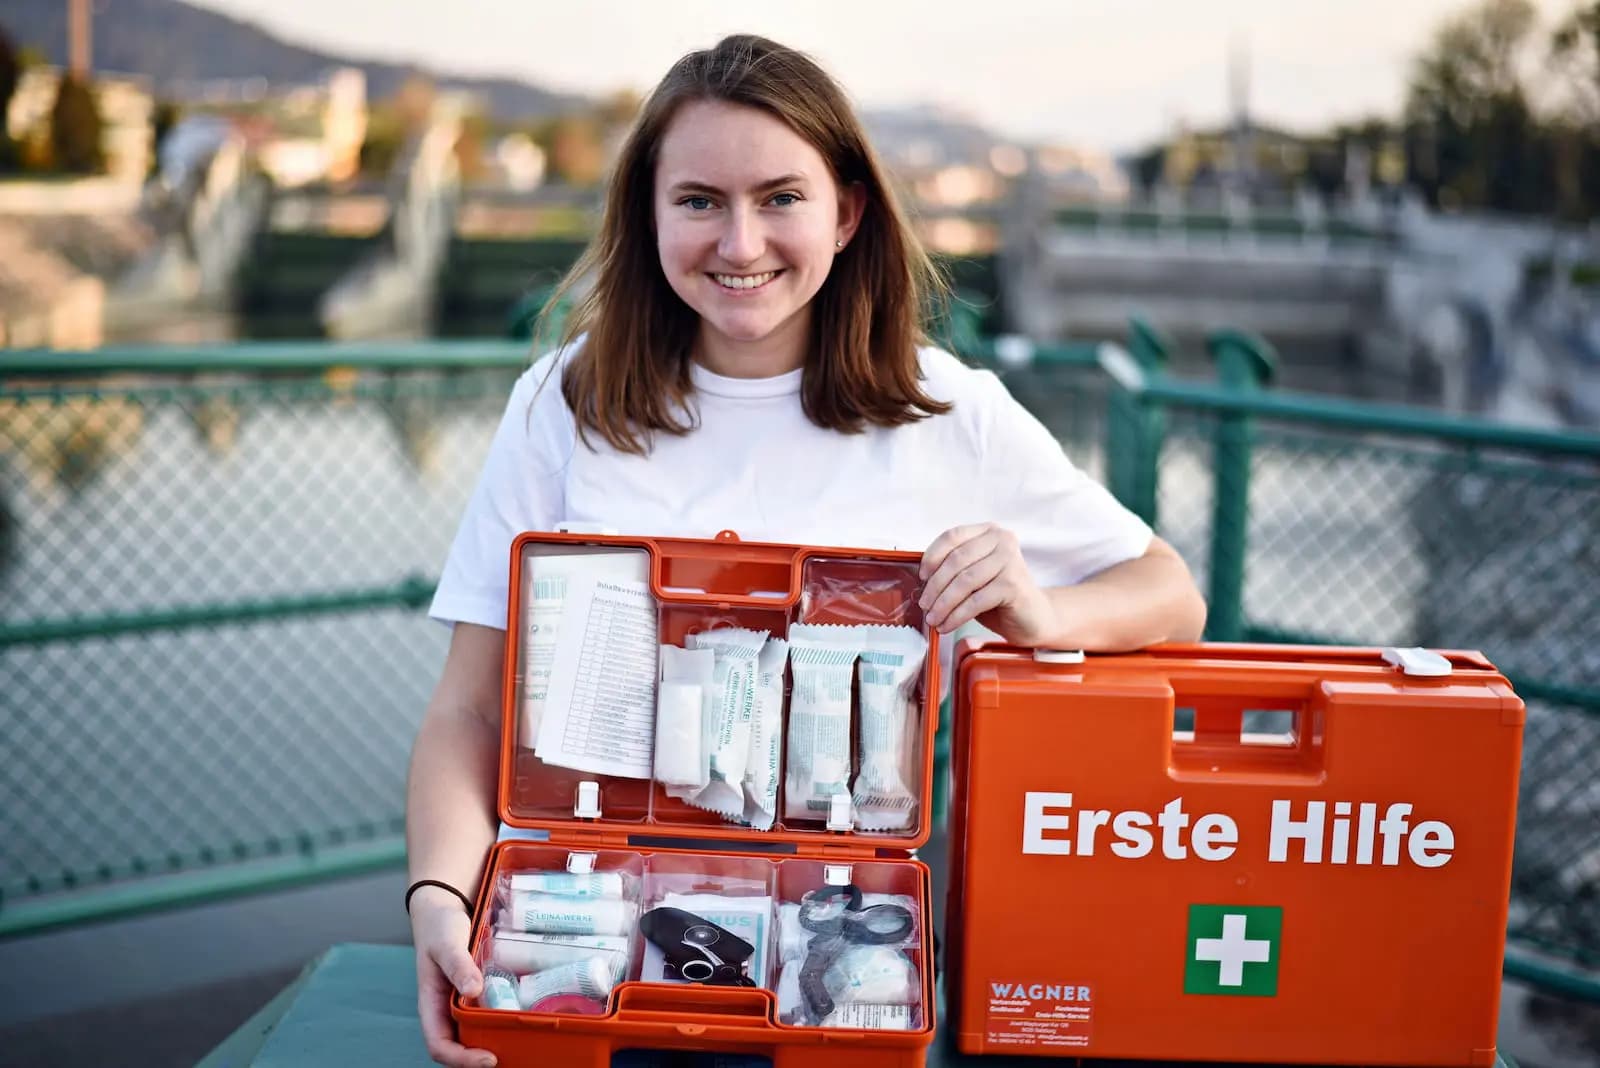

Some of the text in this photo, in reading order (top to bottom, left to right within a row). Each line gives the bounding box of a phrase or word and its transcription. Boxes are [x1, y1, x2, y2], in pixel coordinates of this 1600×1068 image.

[1022, 791, 1455, 868] Erste Hilfe
[991, 982, 1091, 1001] WAGNER
